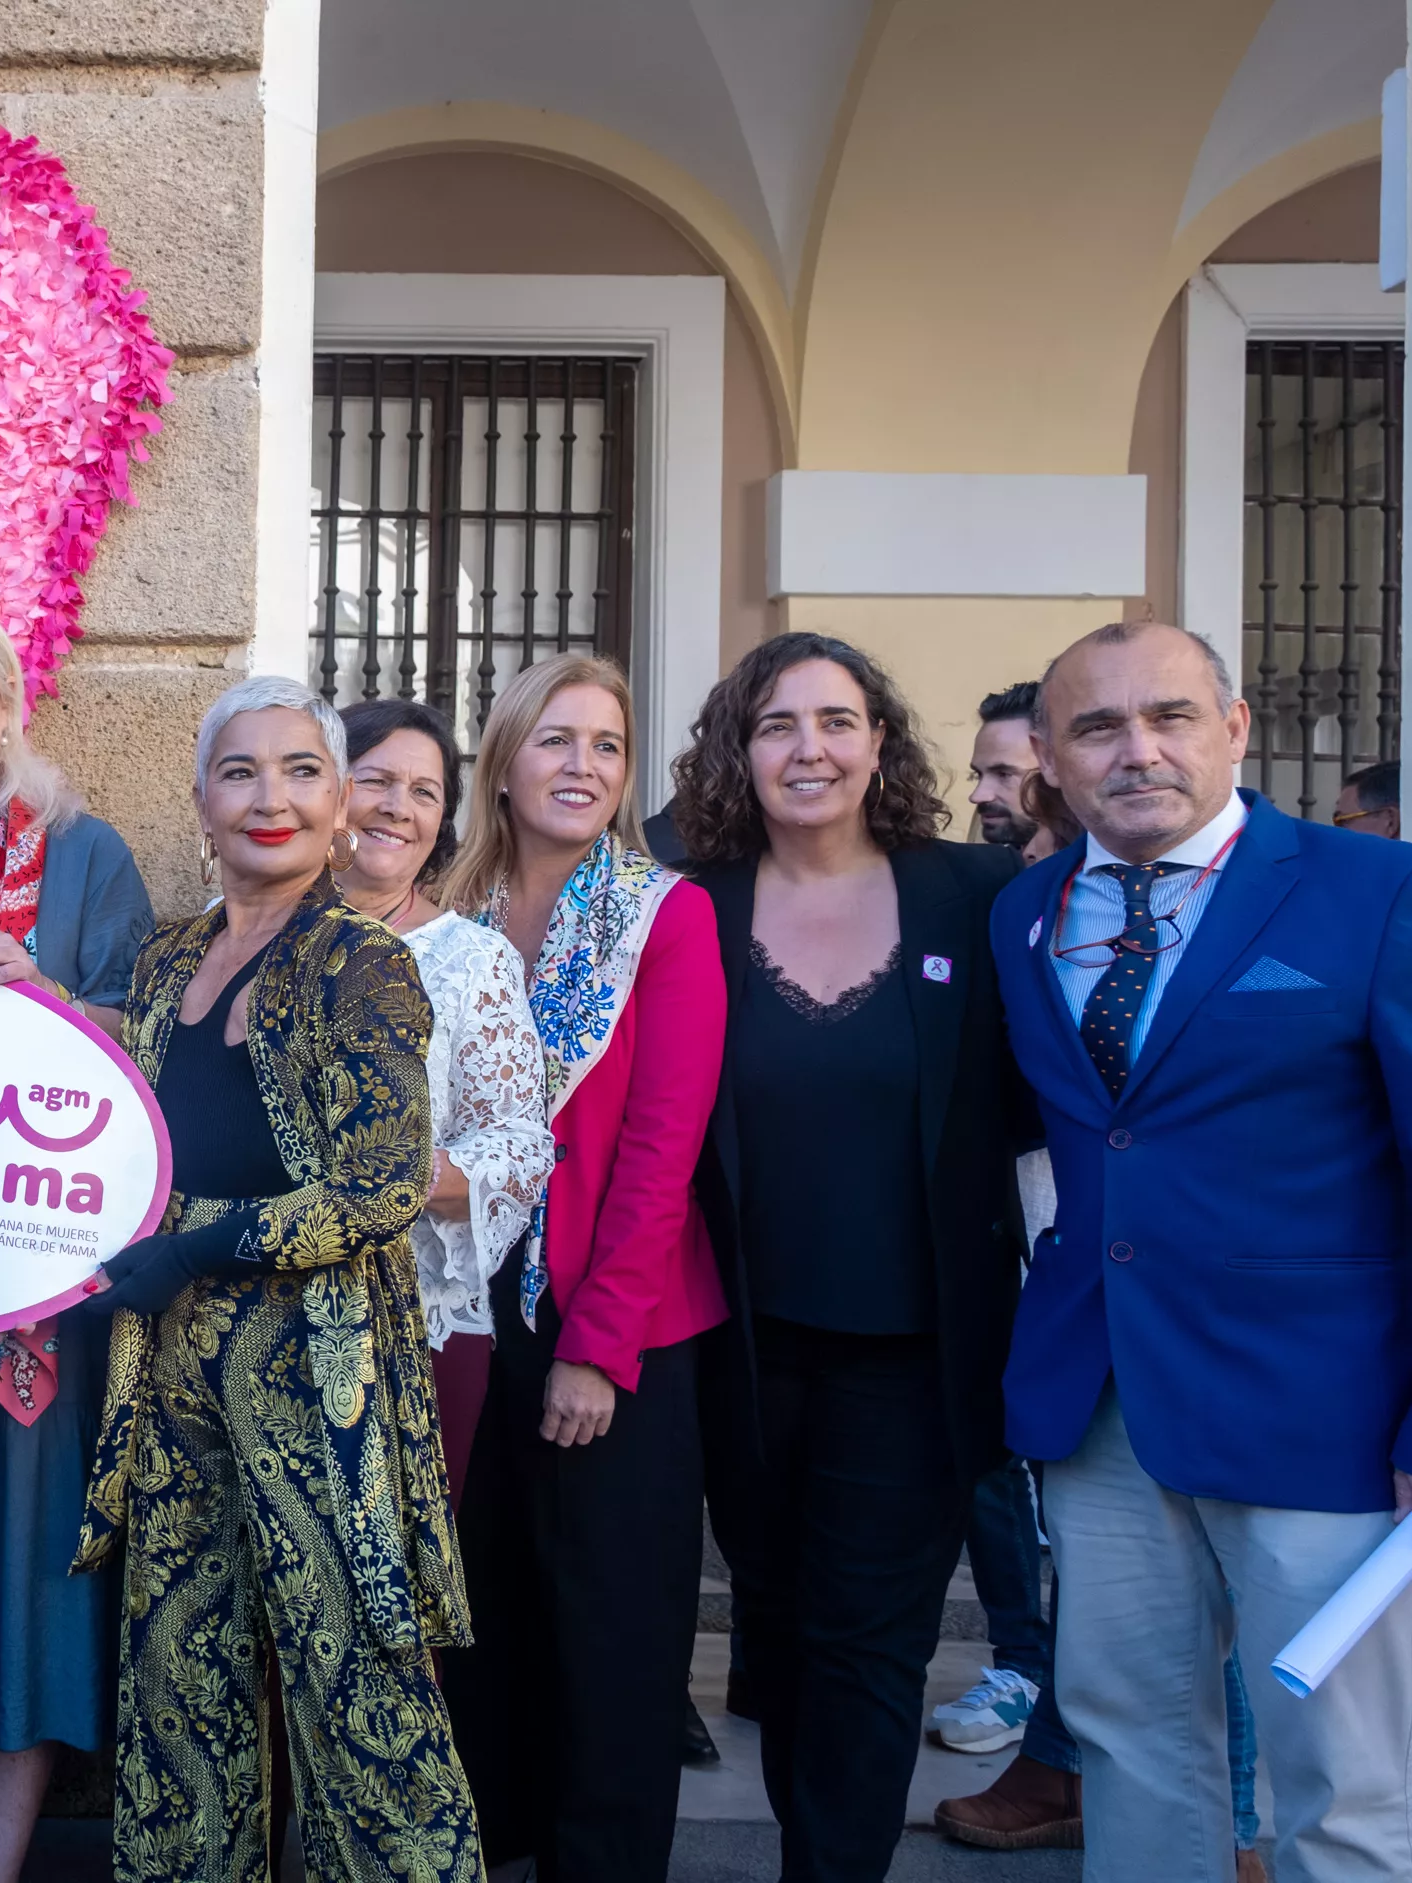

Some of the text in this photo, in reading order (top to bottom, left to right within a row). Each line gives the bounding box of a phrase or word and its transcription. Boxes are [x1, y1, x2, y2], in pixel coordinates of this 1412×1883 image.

[27, 1084, 91, 1111] agm
[27, 1222, 43, 1236] DE
[46, 1225, 99, 1243] MUJERES
[39, 1240, 56, 1253] DE
[58, 1243, 97, 1259] MAMA
